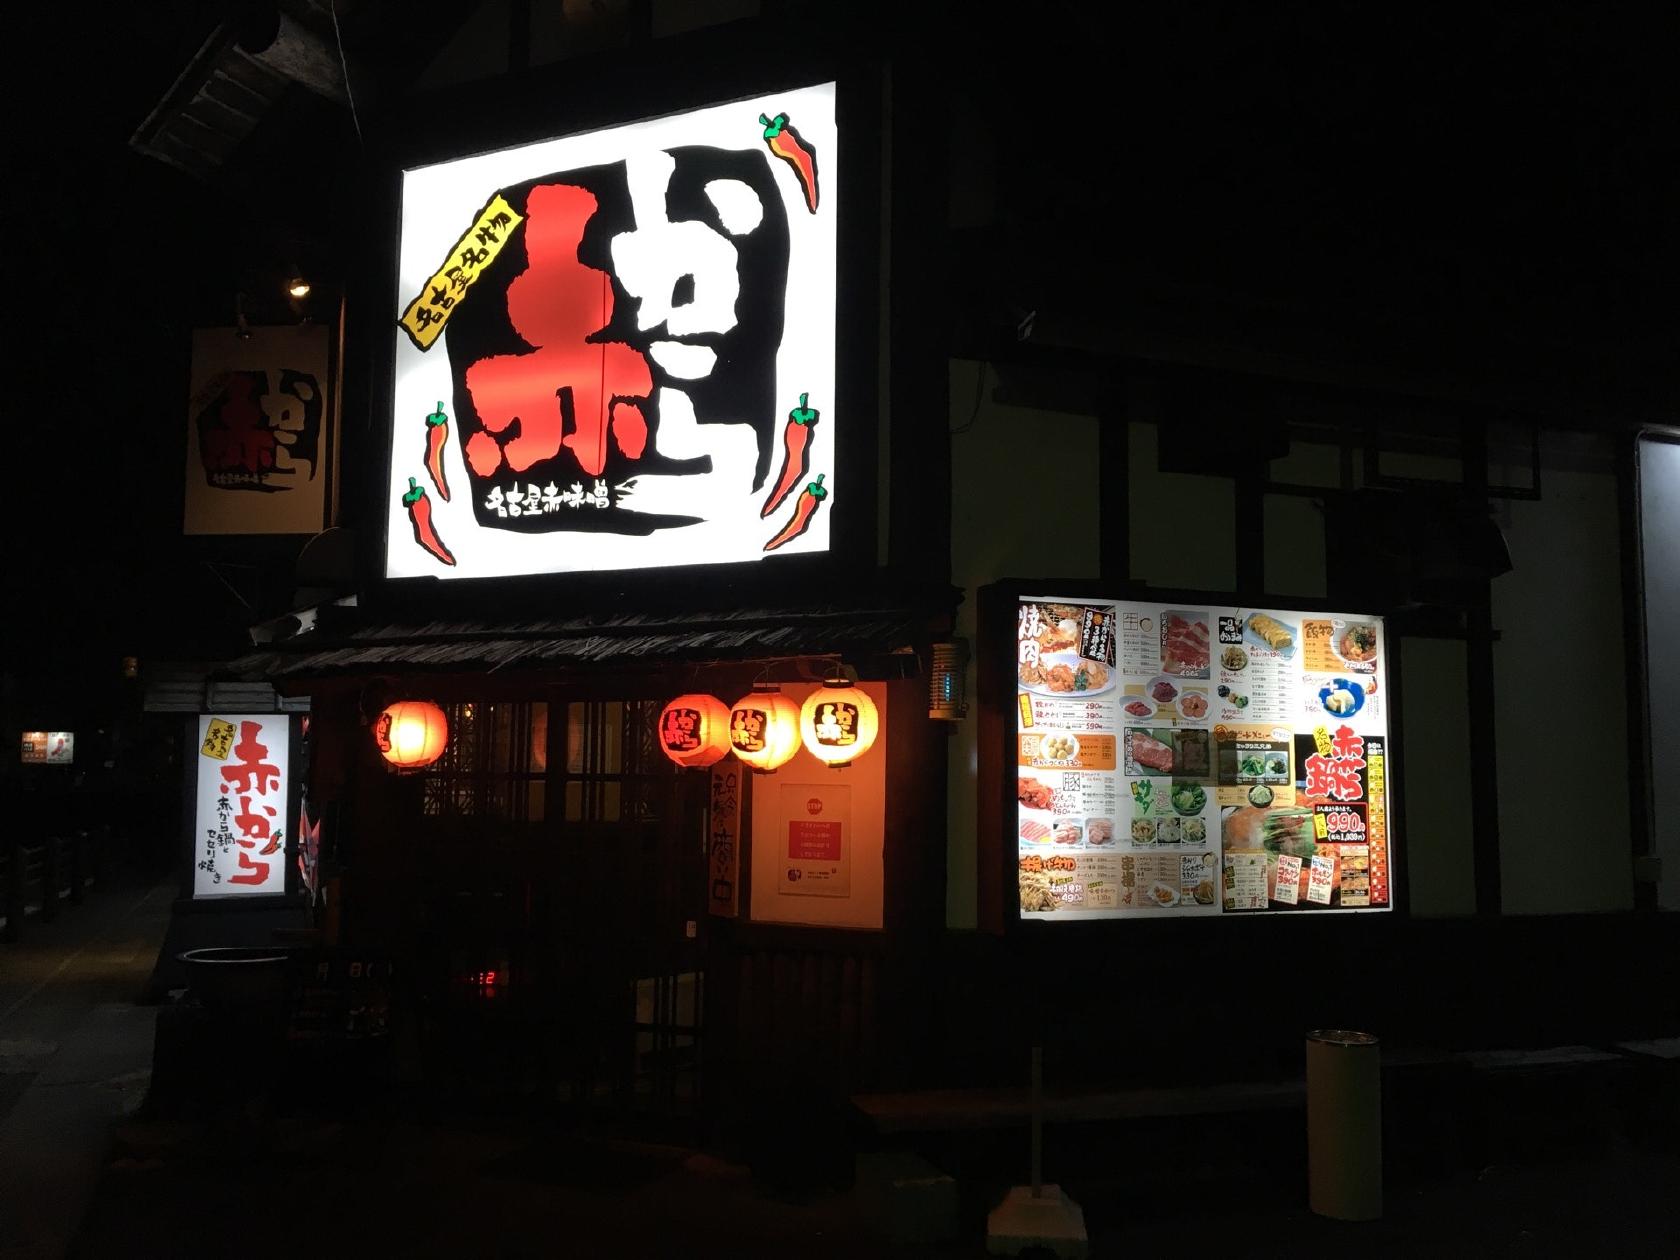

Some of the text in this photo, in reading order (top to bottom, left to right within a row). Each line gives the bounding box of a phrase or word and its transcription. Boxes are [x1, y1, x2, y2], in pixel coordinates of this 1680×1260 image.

[416, 211, 512, 332] 名古屋名物
[485, 479, 610, 518] 名古屋赤味噌
[220, 720, 280, 886] 赤から
